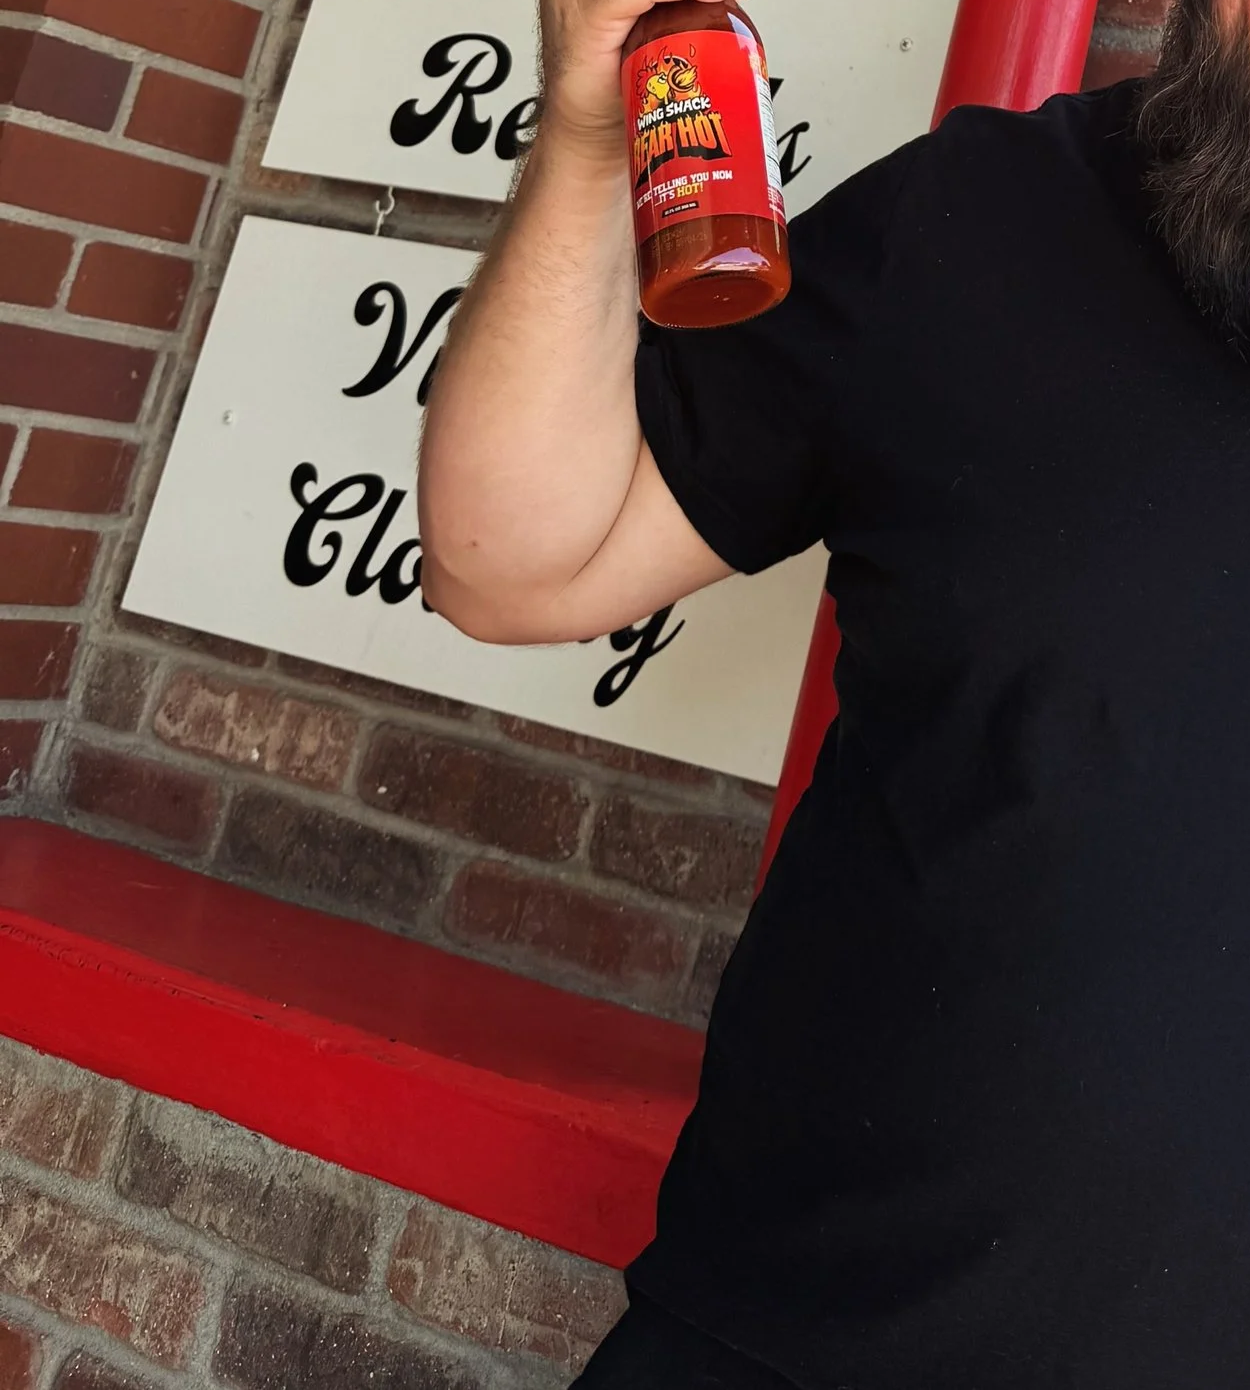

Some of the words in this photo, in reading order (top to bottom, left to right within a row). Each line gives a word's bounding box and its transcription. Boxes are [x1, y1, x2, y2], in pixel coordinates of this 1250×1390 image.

[637, 108, 664, 130] WING
[665, 96, 711, 117] SHACK
[677, 111, 732, 156] HOT
[653, 176, 688, 197] TELLING
[690, 172, 709, 183] YOU
[712, 170, 733, 180] NOW
[676, 181, 704, 198] HOT!
